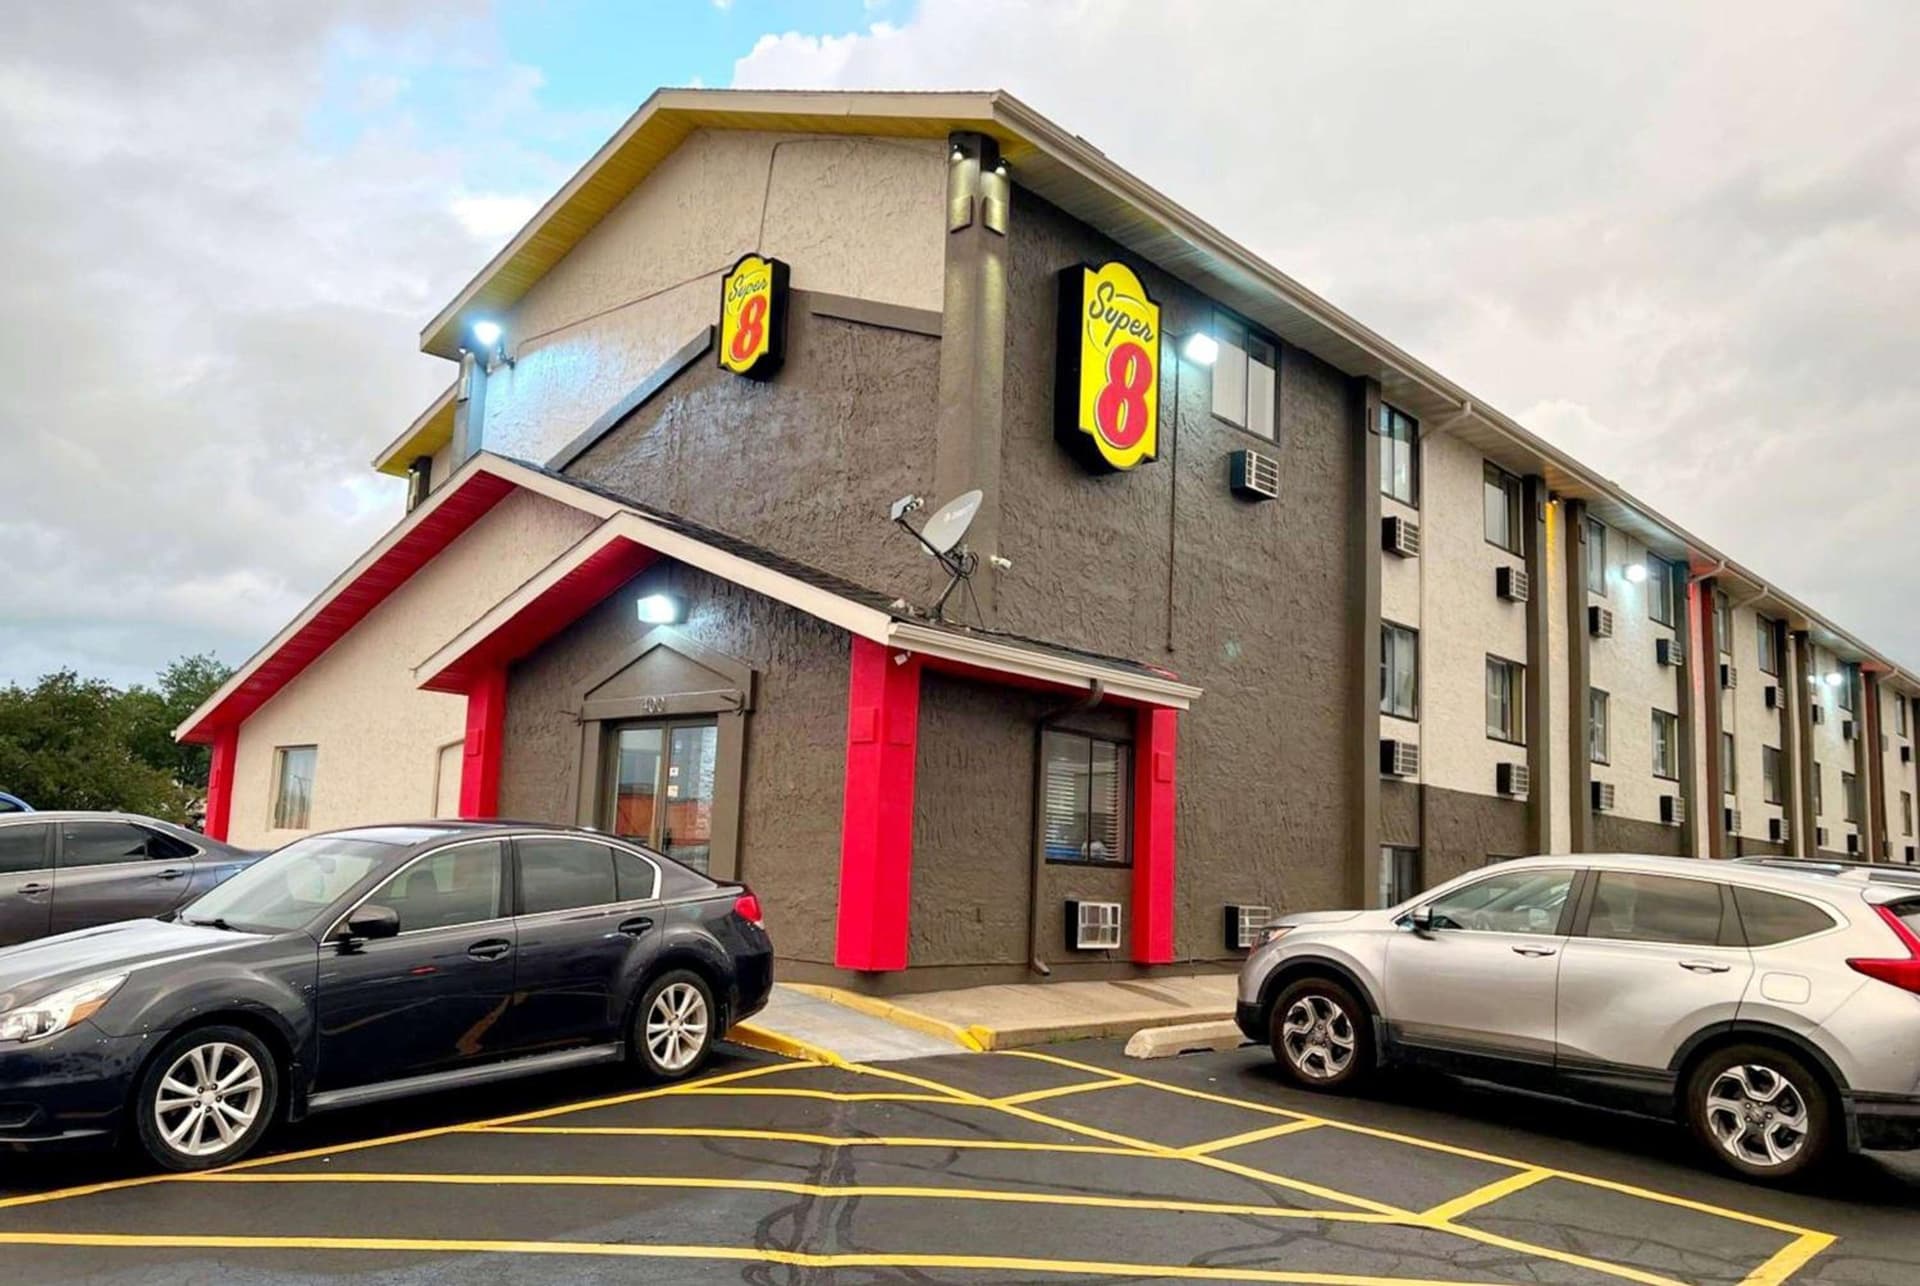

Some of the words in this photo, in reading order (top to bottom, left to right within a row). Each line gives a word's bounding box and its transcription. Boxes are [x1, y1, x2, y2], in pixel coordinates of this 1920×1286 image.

[728, 274, 768, 312] Super
[1088, 281, 1154, 347] Super
[729, 294, 767, 362] 8
[1094, 342, 1153, 449] 8
